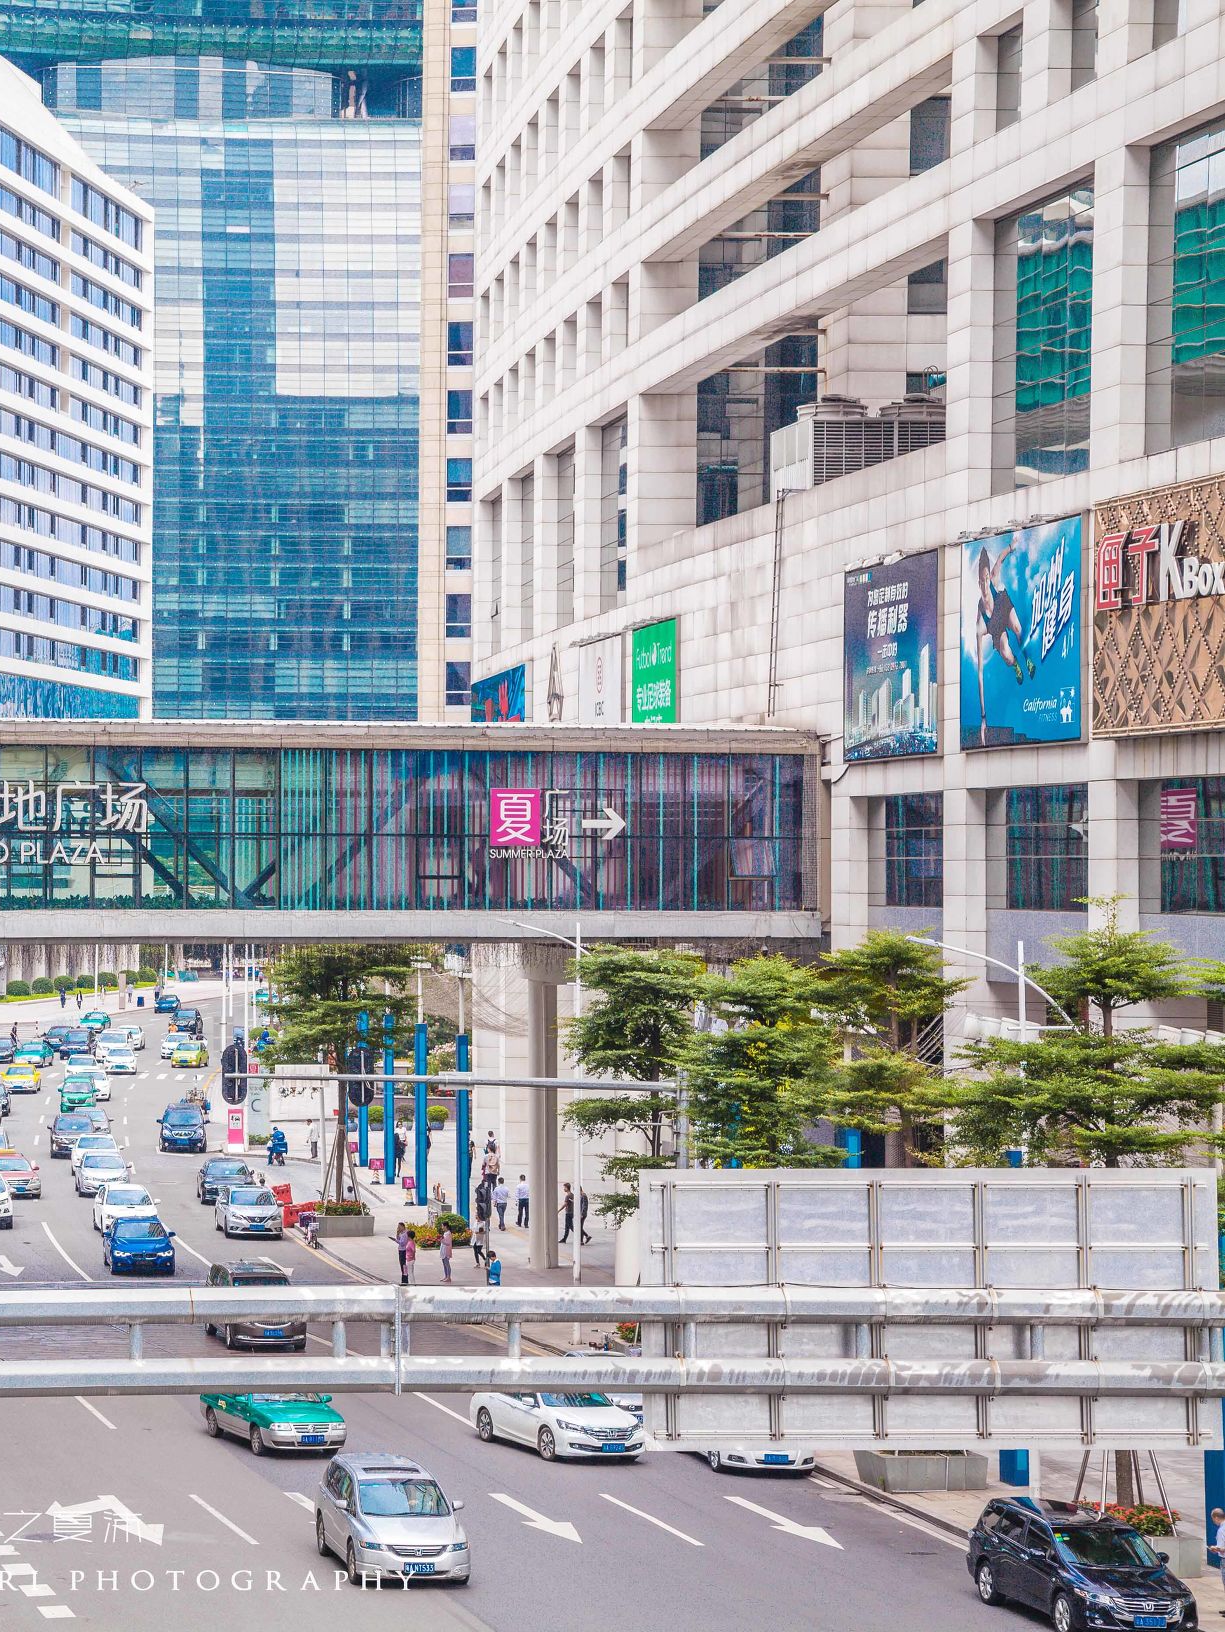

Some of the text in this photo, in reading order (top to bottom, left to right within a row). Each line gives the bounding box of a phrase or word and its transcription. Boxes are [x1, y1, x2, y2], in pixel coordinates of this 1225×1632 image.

[867, 602, 909, 639] 传播利器
[1023, 696, 1057, 714] California
[496, 793, 535, 842] 夏
[20, 841, 105, 865] PLAZA
[489, 848, 569, 859] SUMMER PLAZA
